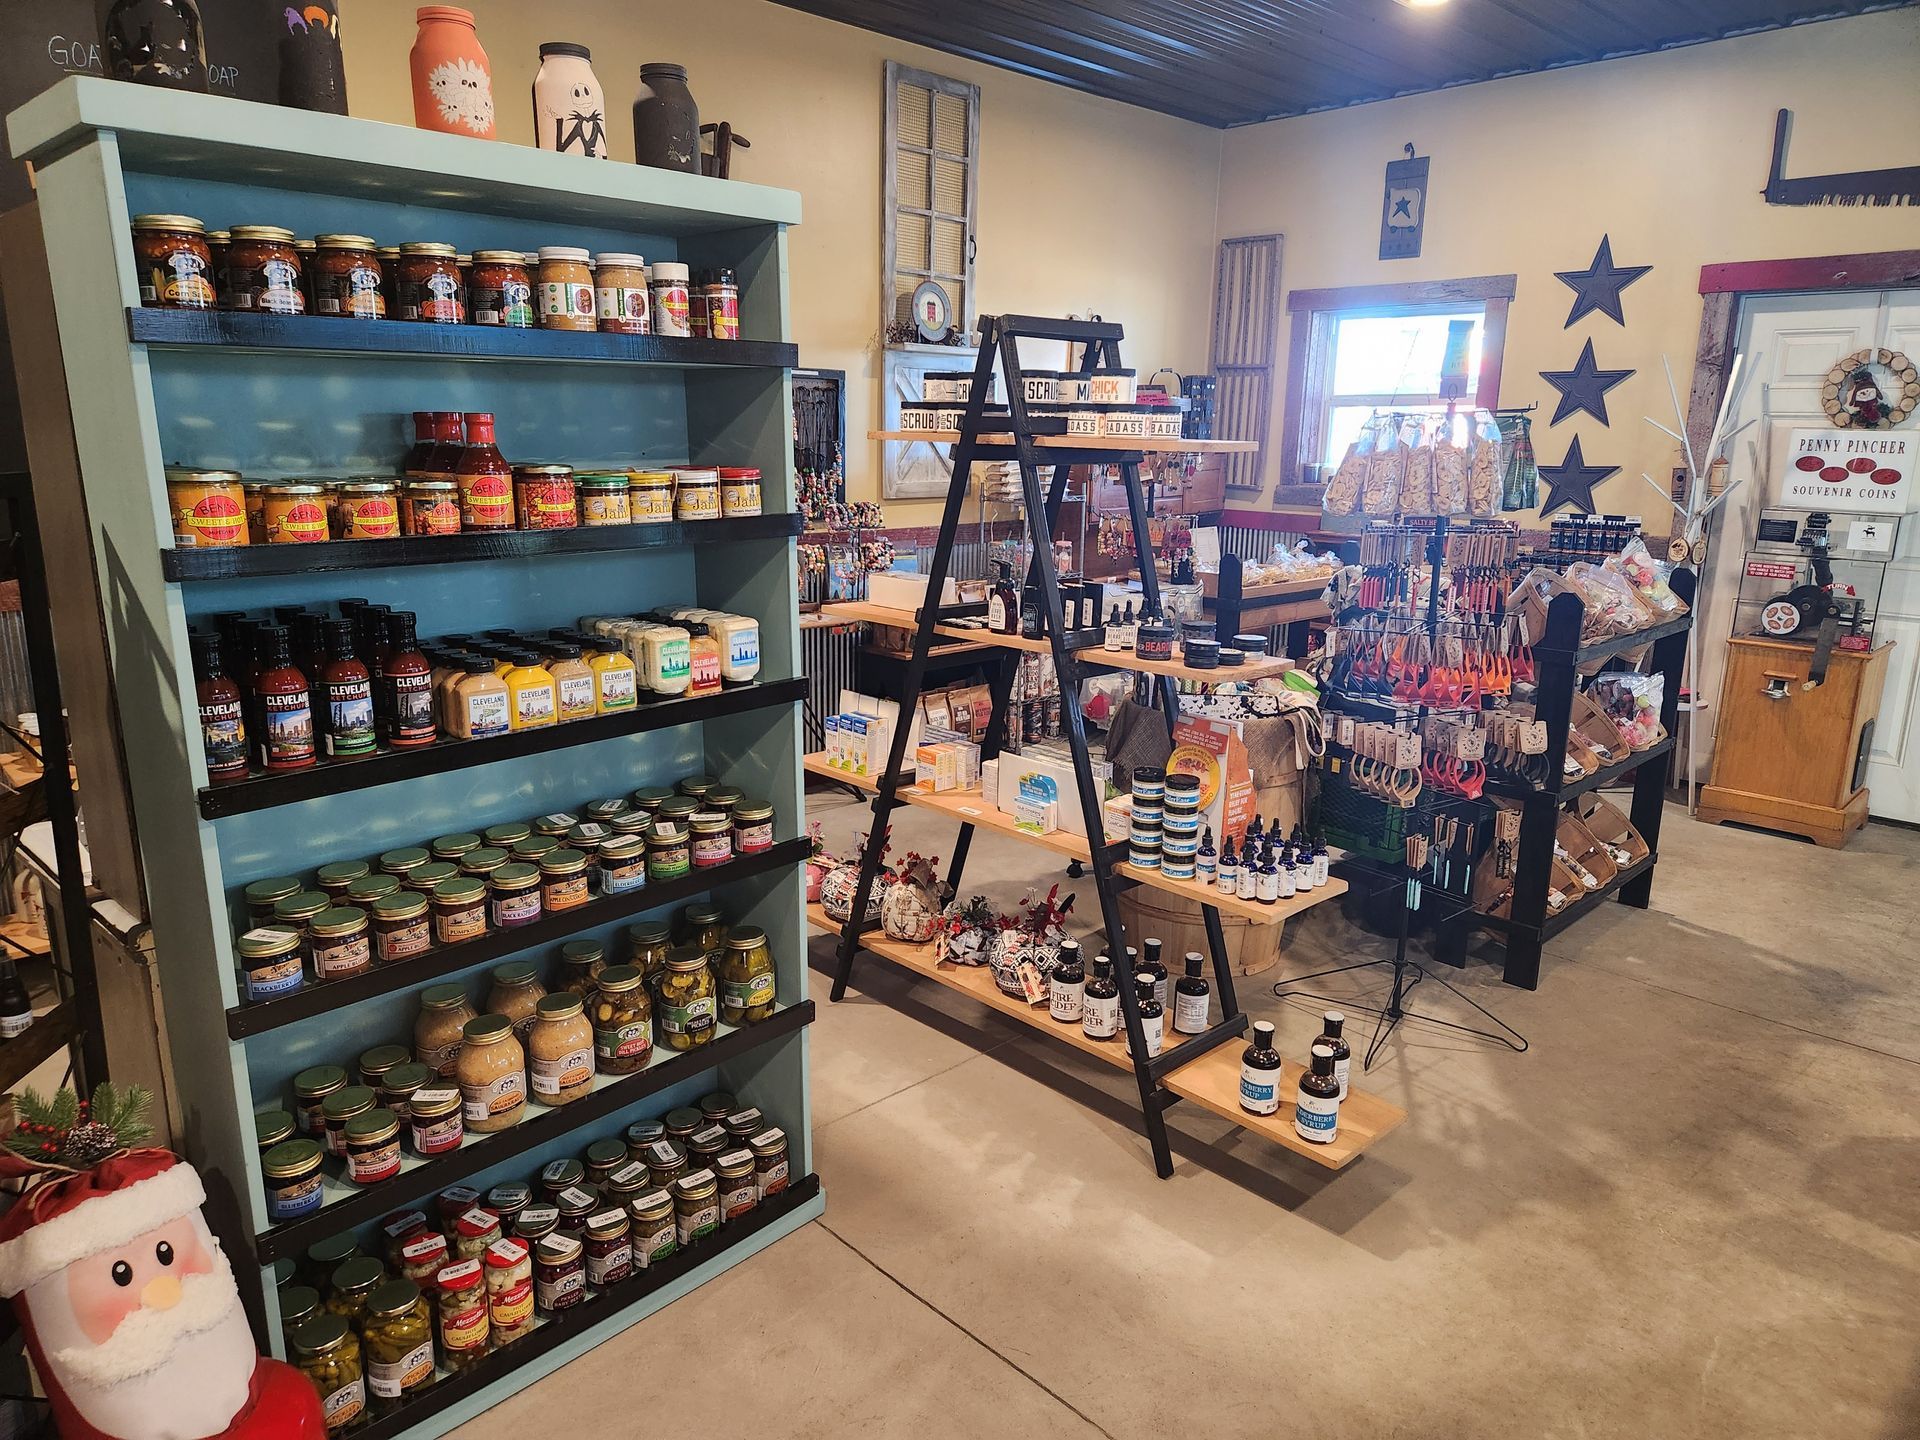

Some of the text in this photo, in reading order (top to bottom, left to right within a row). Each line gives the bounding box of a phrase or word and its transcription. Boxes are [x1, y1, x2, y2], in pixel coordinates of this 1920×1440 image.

[48, 35, 238, 88] GOA OAP
[903, 412, 934, 429] SCRUB
[1069, 421, 1096, 432] DASS
[1799, 438, 1906, 455] PENNY PINCHER
[475, 483, 504, 494] BEN'S
[1792, 485, 1897, 499] SOUVENIR COINS
[469, 496, 493, 504] SWEET
[199, 500, 236, 516] BEN'S
[361, 507, 390, 516] BEN'S
[435, 508, 456, 516] BEN'S
[291, 510, 321, 521] BEN'S
[191, 517, 223, 526] SWEET
[1826, 582, 1849, 591] TURN
[520, 688, 550, 699] CLEVELAND
[472, 695, 505, 706] CLEVELAND
[201, 712, 238, 723] ETCHUP
[253, 981, 292, 991] BLACKBERRY
[1051, 990, 1074, 1002] FIRE
[1084, 1014, 1103, 1026] DER
[502, 1287, 531, 1305] Mezzetta
[453, 1308, 484, 1328] Mezzetta
